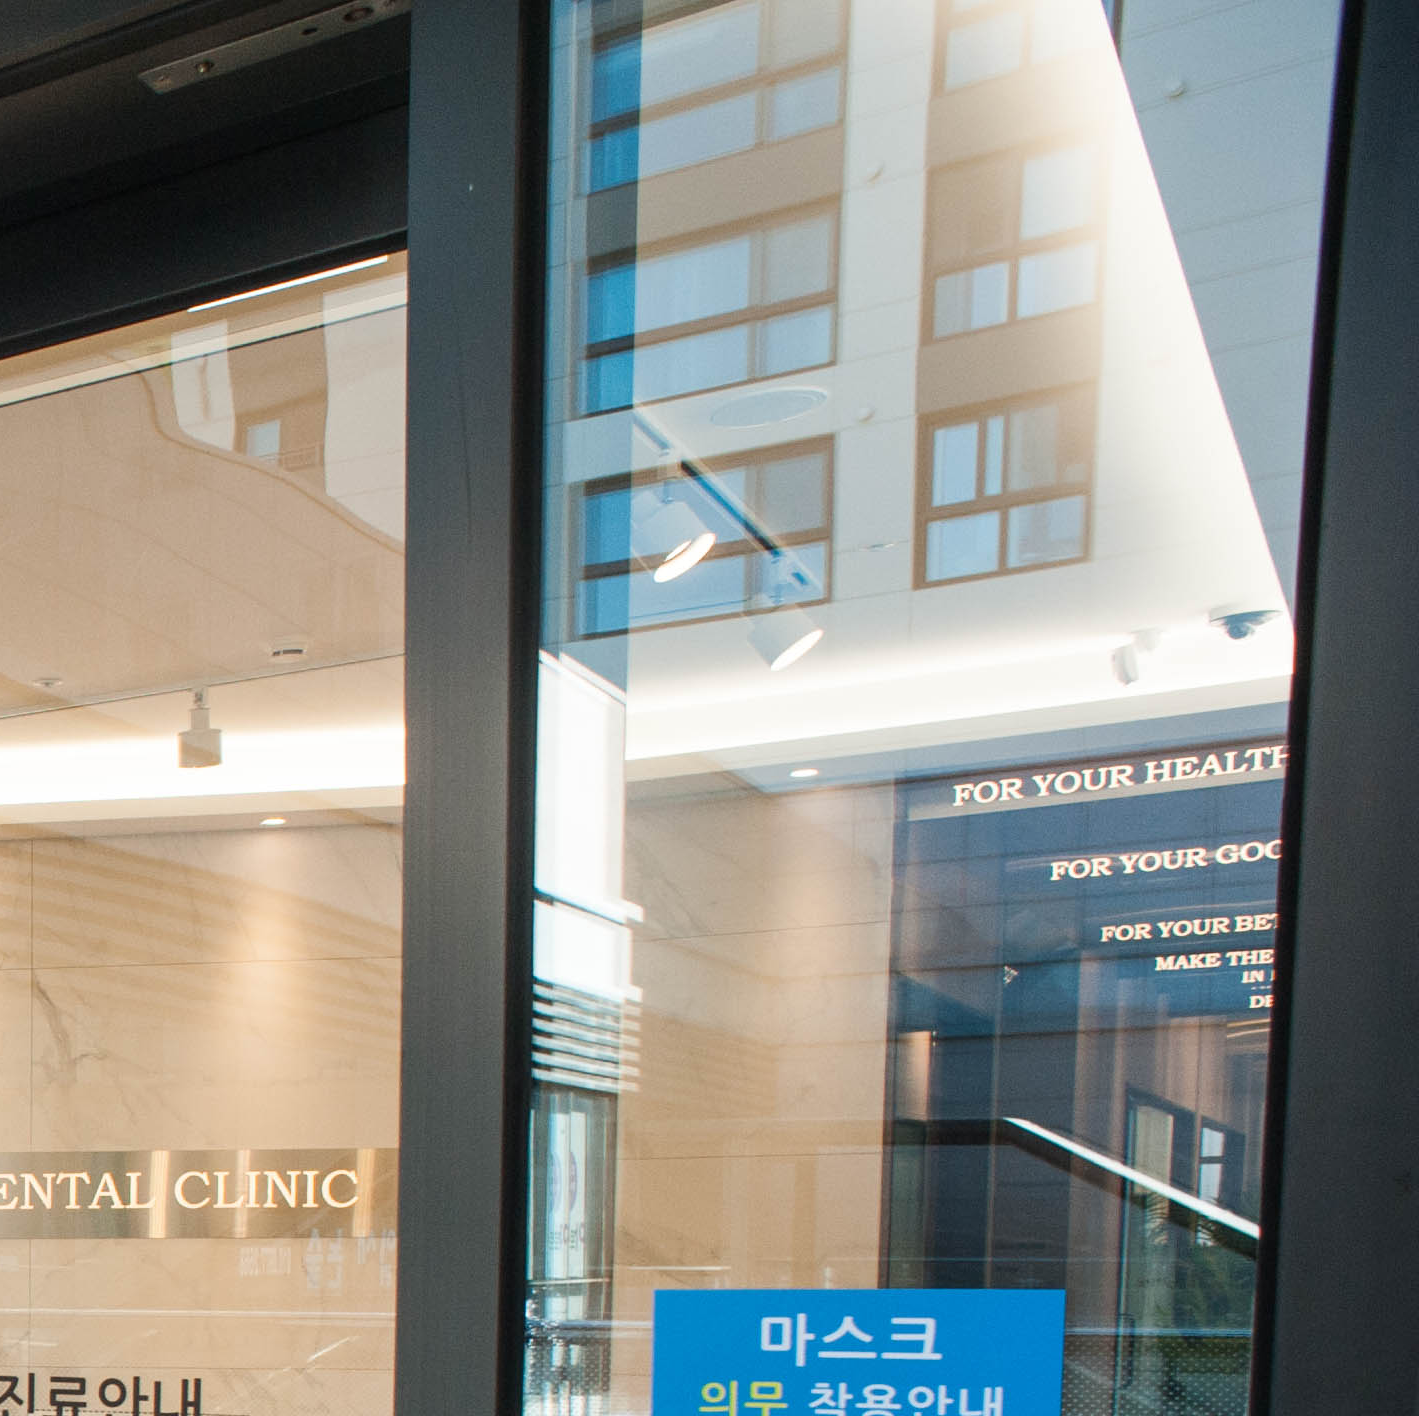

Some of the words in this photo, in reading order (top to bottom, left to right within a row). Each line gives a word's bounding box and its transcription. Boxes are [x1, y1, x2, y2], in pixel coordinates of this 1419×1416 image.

[953, 778, 1024, 806] FOR
[1032, 764, 1134, 797] YOUR
[1050, 857, 1113, 881] FOR
[1120, 847, 1209, 875] YOUR
[1100, 922, 1152, 942] FOR
[1156, 916, 1230, 938] YOUR
[1155, 952, 1222, 971] MAKE
[1241, 969, 1265, 984] IN
[174, 1168, 361, 1210] CLINIC
[760, 1313, 943, 1367] 마스크
